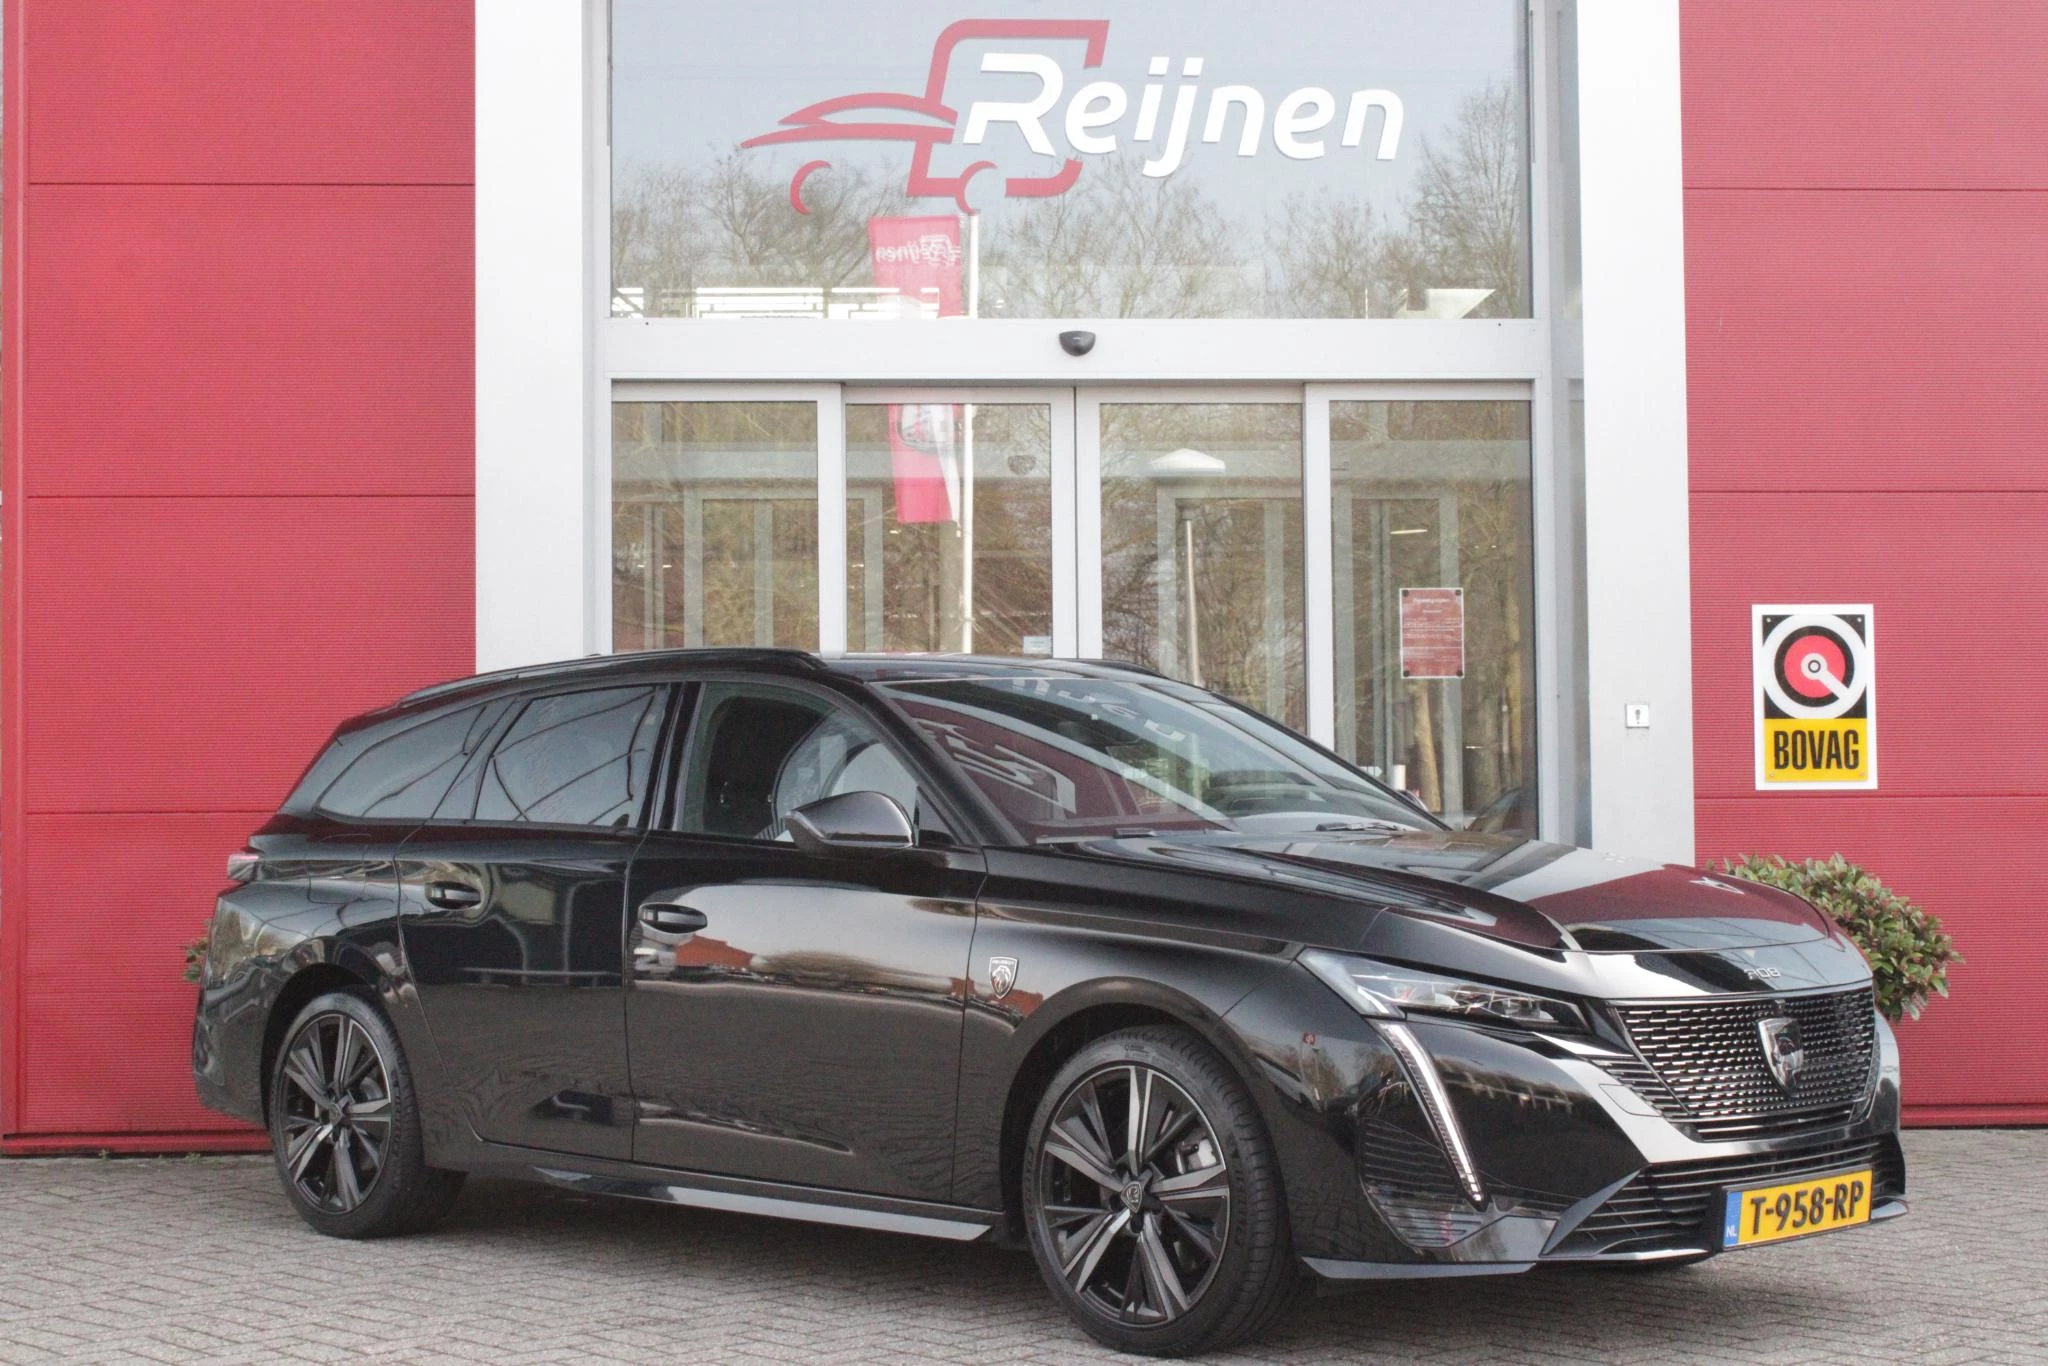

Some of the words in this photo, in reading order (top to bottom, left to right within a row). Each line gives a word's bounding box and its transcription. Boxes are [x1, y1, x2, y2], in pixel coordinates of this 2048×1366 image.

[963, 52, 1405, 178] Reijnen
[1774, 729, 1859, 770] BOVAG
[1726, 1224, 1738, 1237] NL
[1751, 1180, 1864, 1235] T-958-RP
